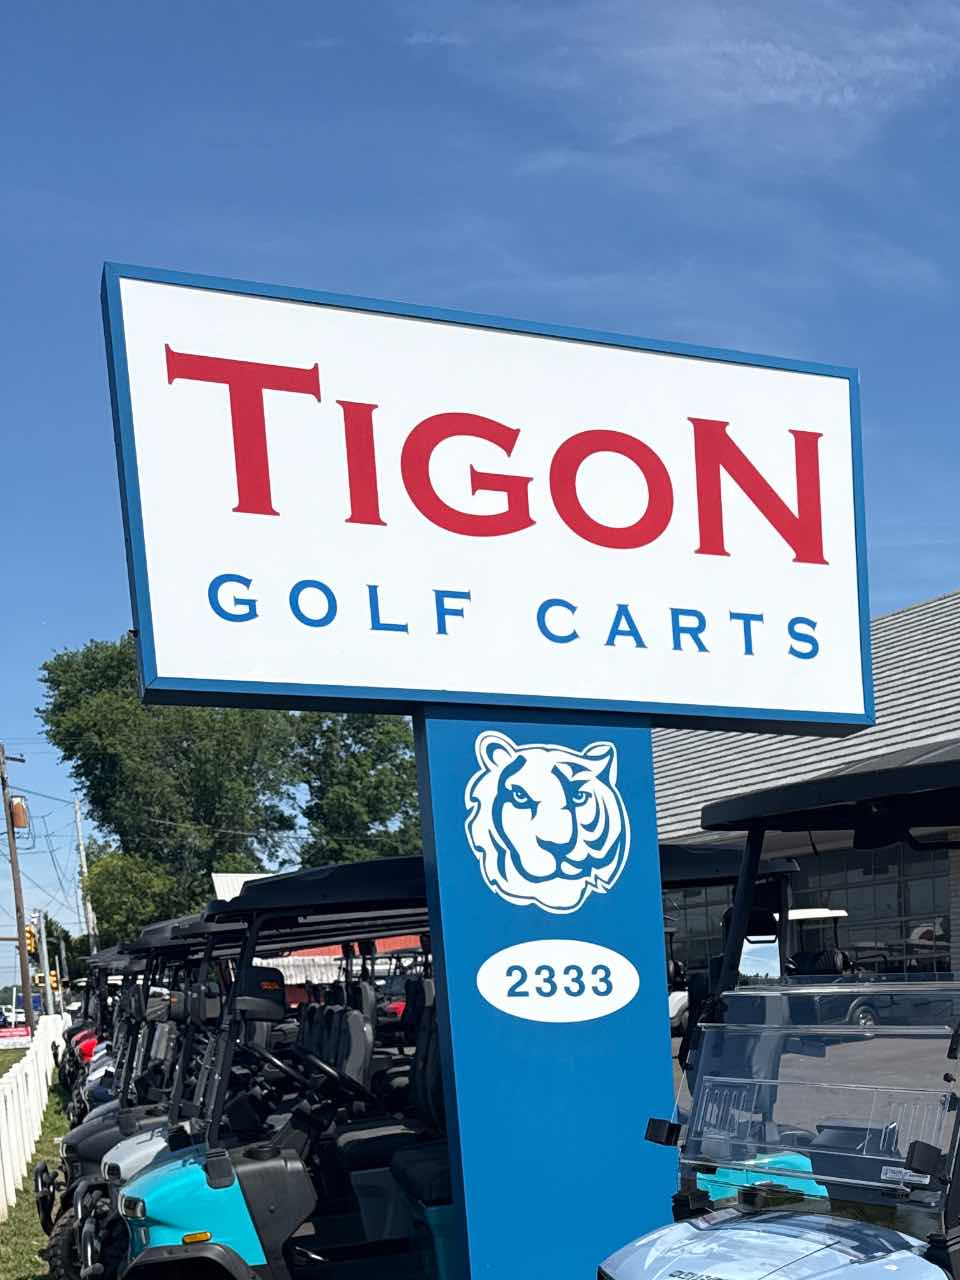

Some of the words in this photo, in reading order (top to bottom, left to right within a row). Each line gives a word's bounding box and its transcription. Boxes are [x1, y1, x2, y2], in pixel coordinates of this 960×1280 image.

[165, 344, 828, 565] TIGON
[208, 574, 471, 636] GOLF
[536, 597, 820, 661] CARTS
[506, 964, 613, 998] 2333
